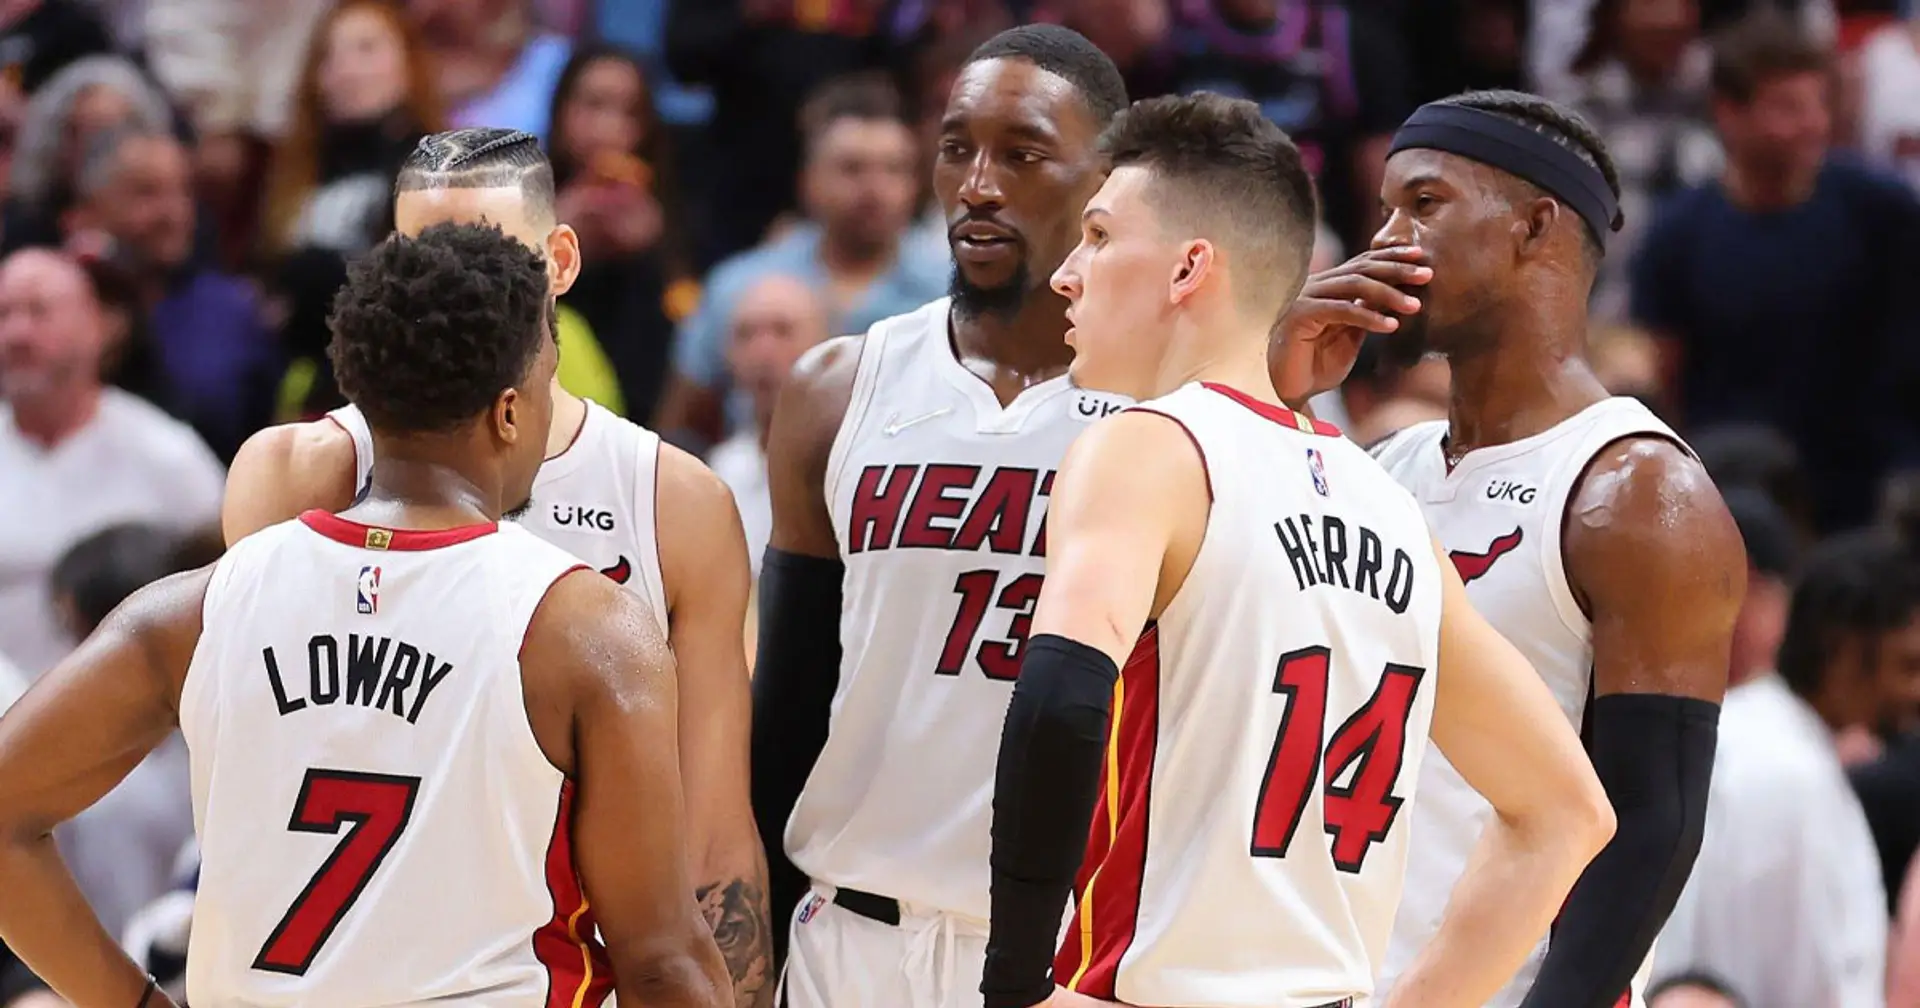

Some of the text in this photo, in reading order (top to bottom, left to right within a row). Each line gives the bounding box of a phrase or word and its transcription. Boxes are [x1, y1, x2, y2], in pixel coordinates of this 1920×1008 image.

[1274, 513, 1414, 614] HERRO
[263, 634, 453, 725] LOWRY
[1250, 645, 1426, 874] 14
[251, 767, 421, 976] 7
